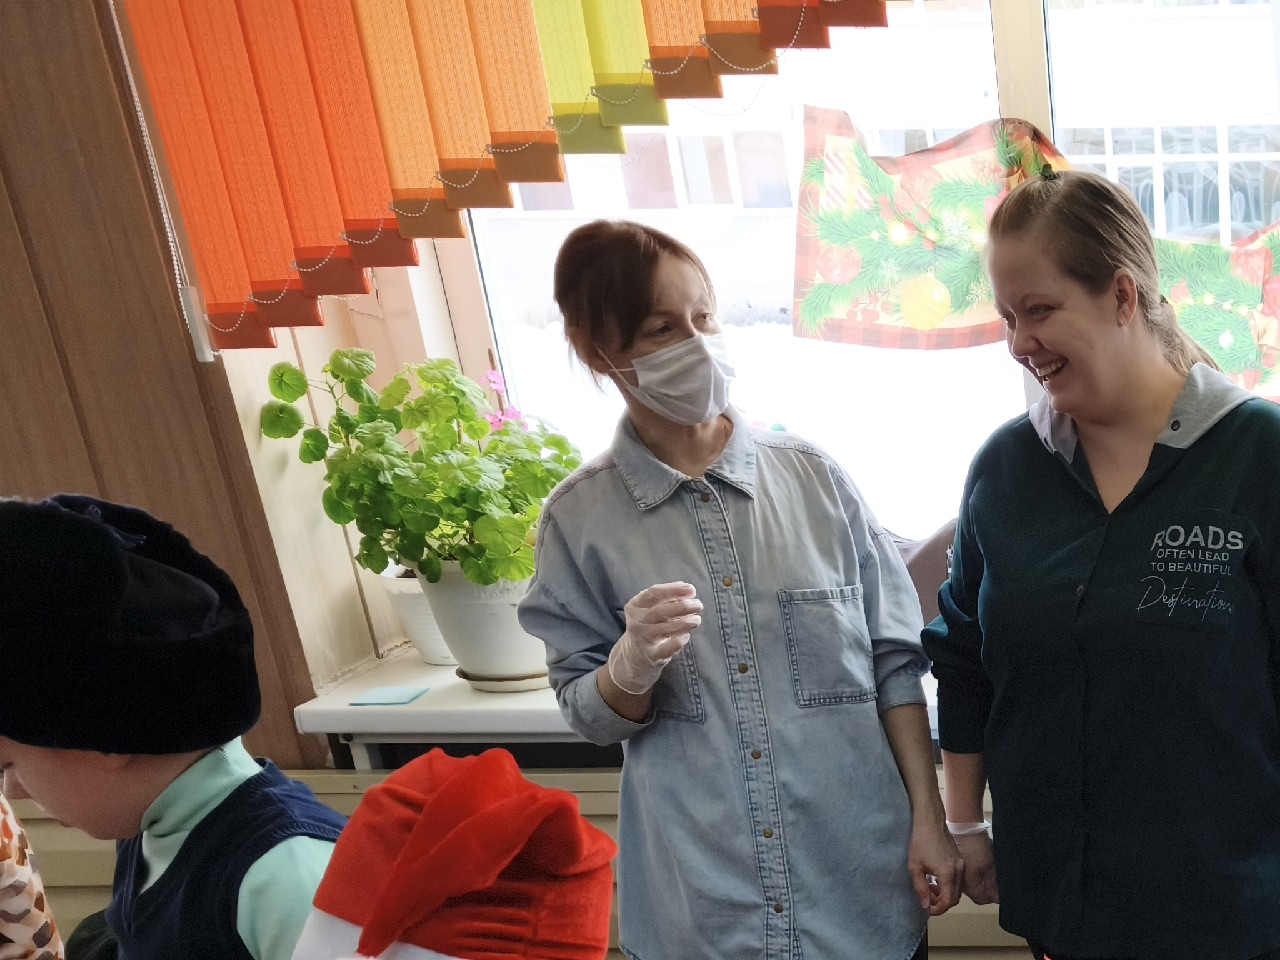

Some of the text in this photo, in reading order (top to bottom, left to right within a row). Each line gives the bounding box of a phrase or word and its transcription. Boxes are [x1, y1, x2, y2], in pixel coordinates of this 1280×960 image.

[1150, 525, 1244, 551] ROADS
[1156, 548, 1230, 562] OFTEN LEAD
[1150, 562, 1232, 576] TO BEAUTIFUL
